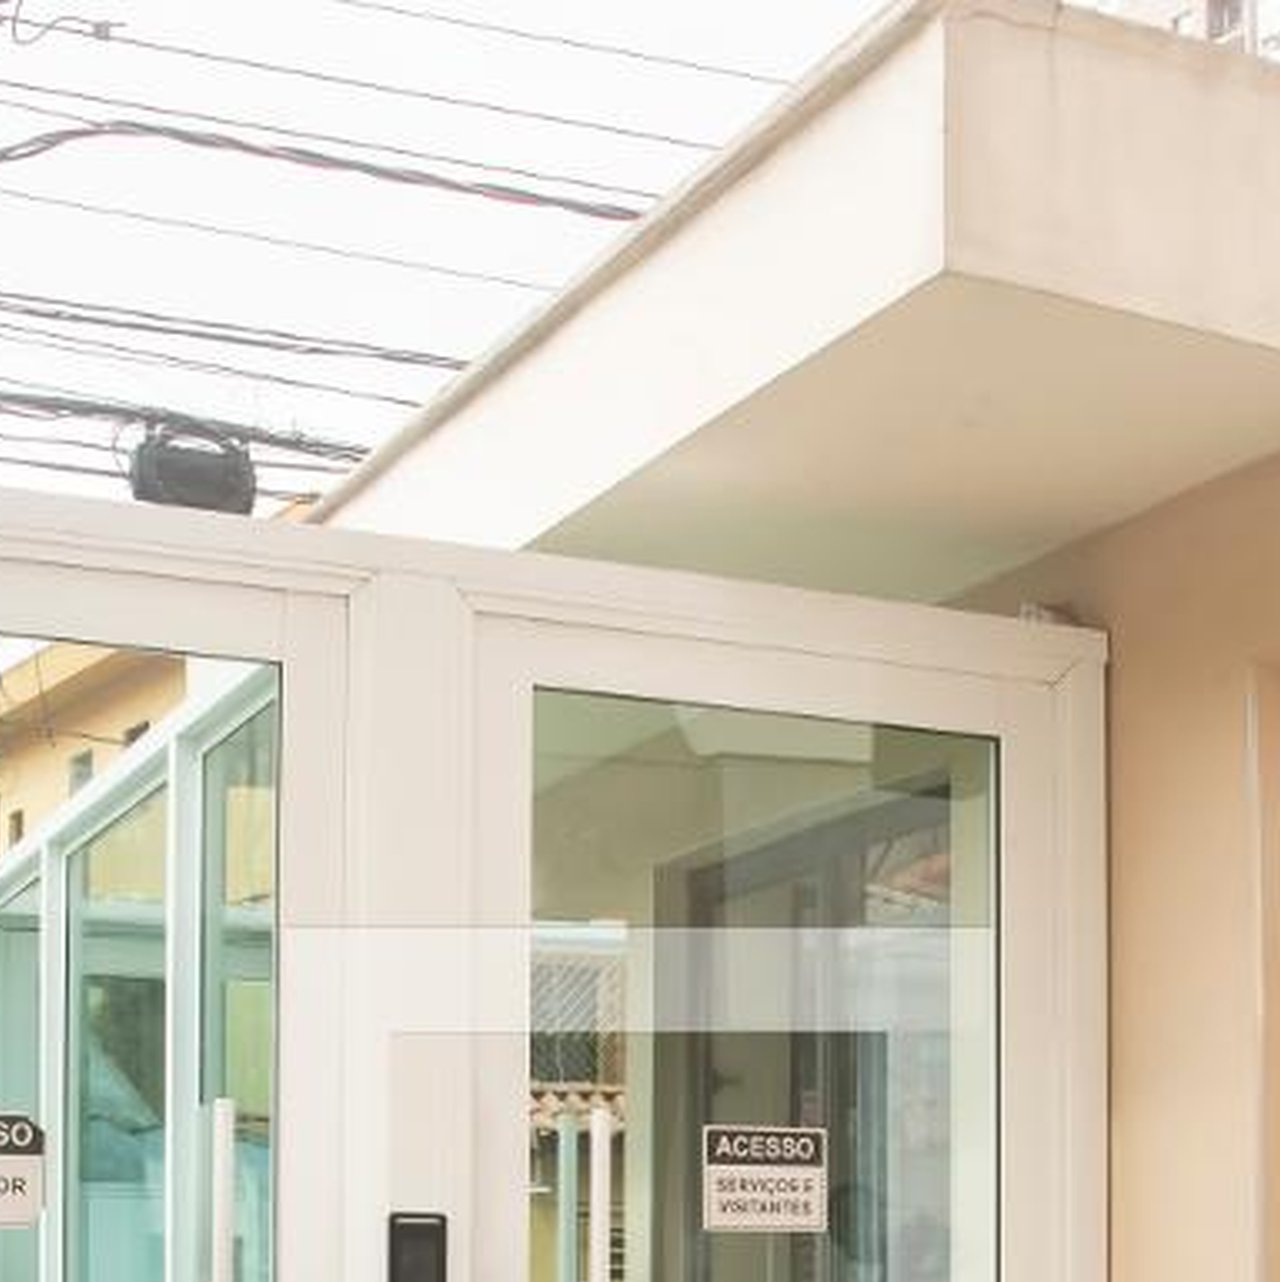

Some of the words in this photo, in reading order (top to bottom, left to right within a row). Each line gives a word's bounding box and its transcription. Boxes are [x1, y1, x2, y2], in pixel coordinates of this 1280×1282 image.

[716, 1135, 816, 1161] ACESSO
[717, 1178, 799, 1195] SERVIÇOS
[721, 1200, 813, 1216] VISITANTES
